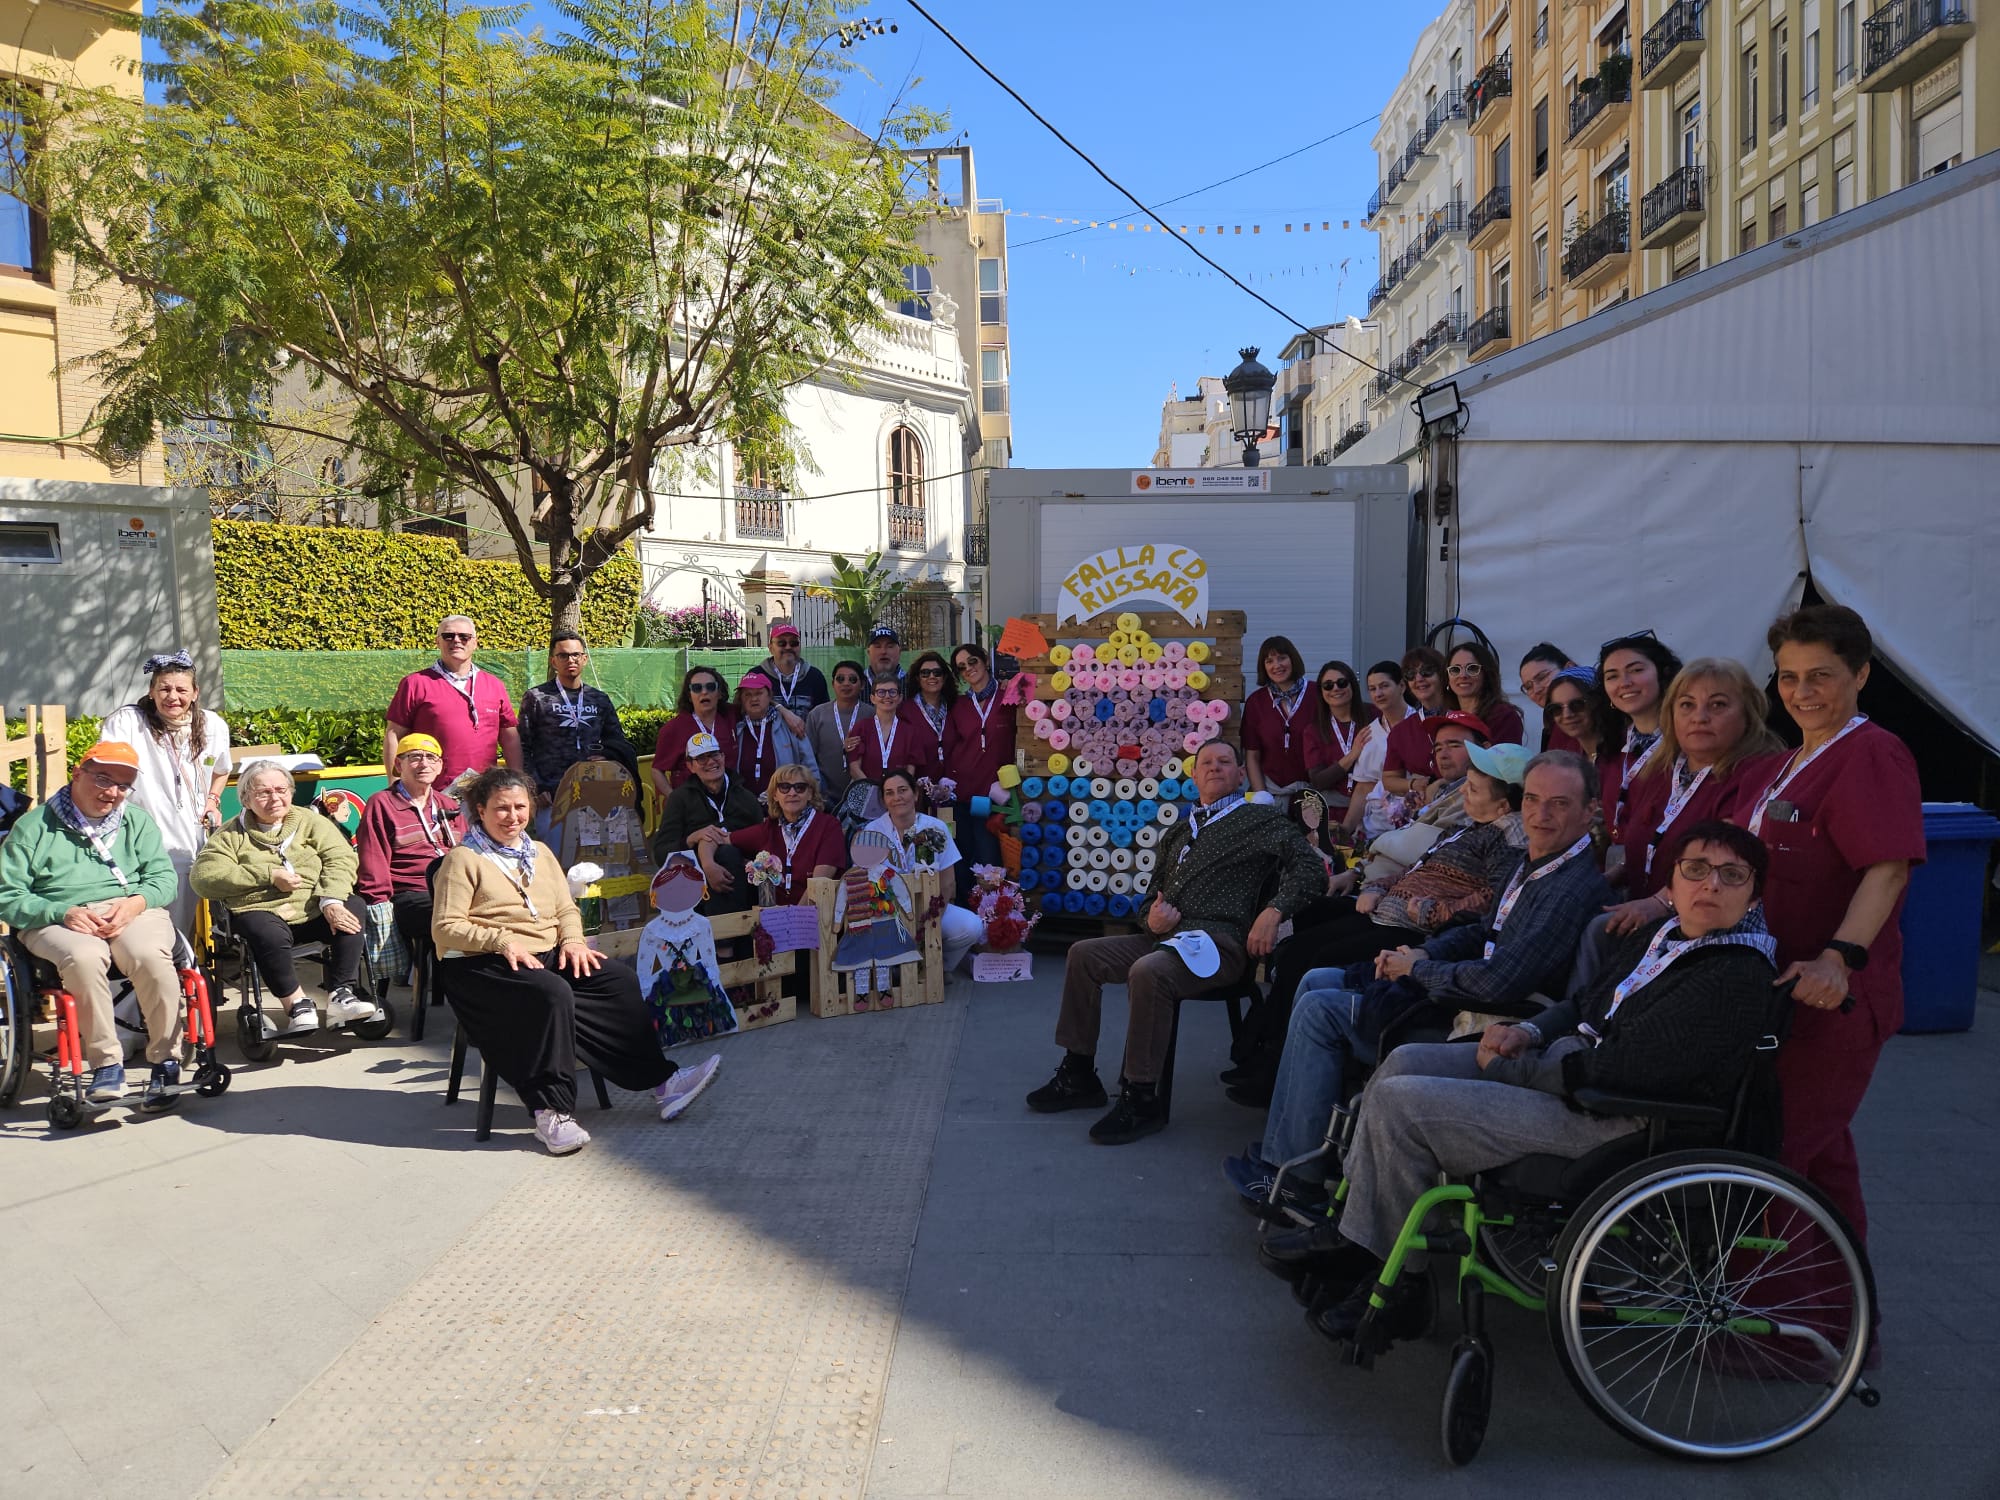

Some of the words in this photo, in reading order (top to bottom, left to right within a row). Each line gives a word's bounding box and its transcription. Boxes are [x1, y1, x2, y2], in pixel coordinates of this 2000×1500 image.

[1062, 544, 1155, 597] FALLA
[1079, 569, 1199, 613] RUSSAFA
[875, 629, 892, 637] NYC
